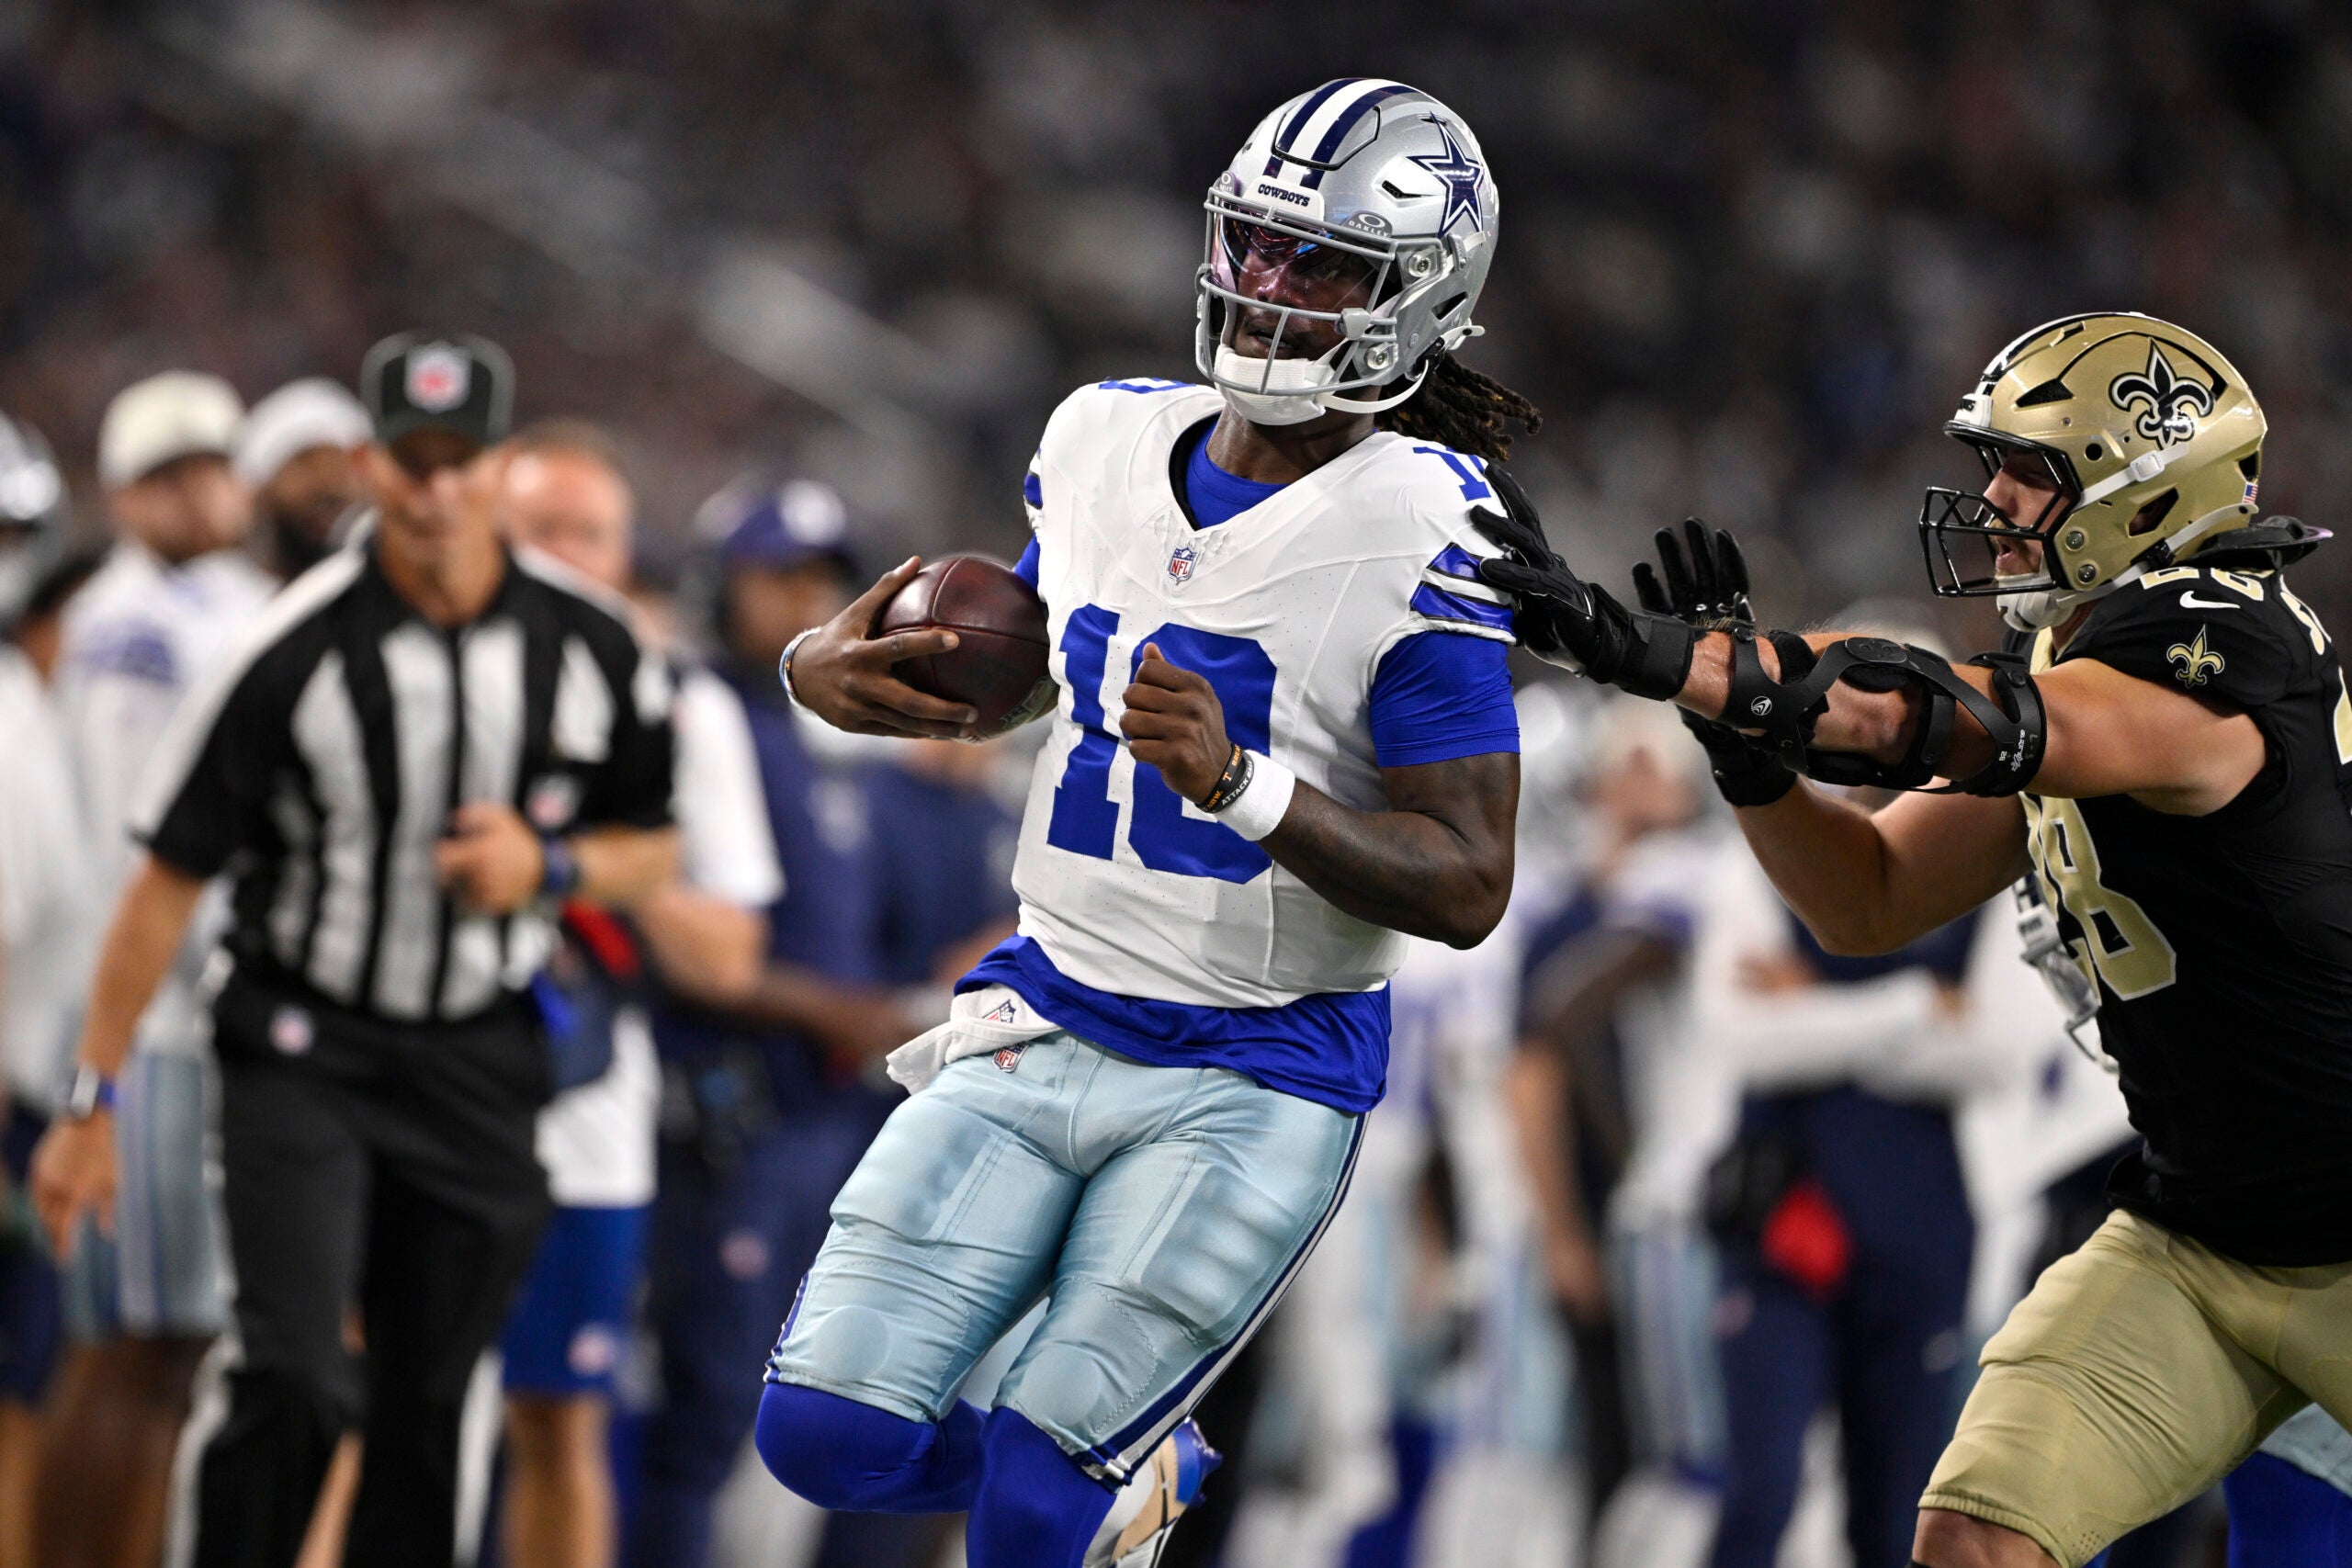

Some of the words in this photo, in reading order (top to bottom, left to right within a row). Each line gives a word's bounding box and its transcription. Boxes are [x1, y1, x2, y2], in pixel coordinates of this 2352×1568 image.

[1258, 184, 1310, 207] COWBOYS
[1349, 220, 1388, 237] OAKLEY
[1171, 559, 1189, 576] NFL
[1222, 778, 1249, 805] ATTACK
[996, 1050, 1014, 1067] NFL
